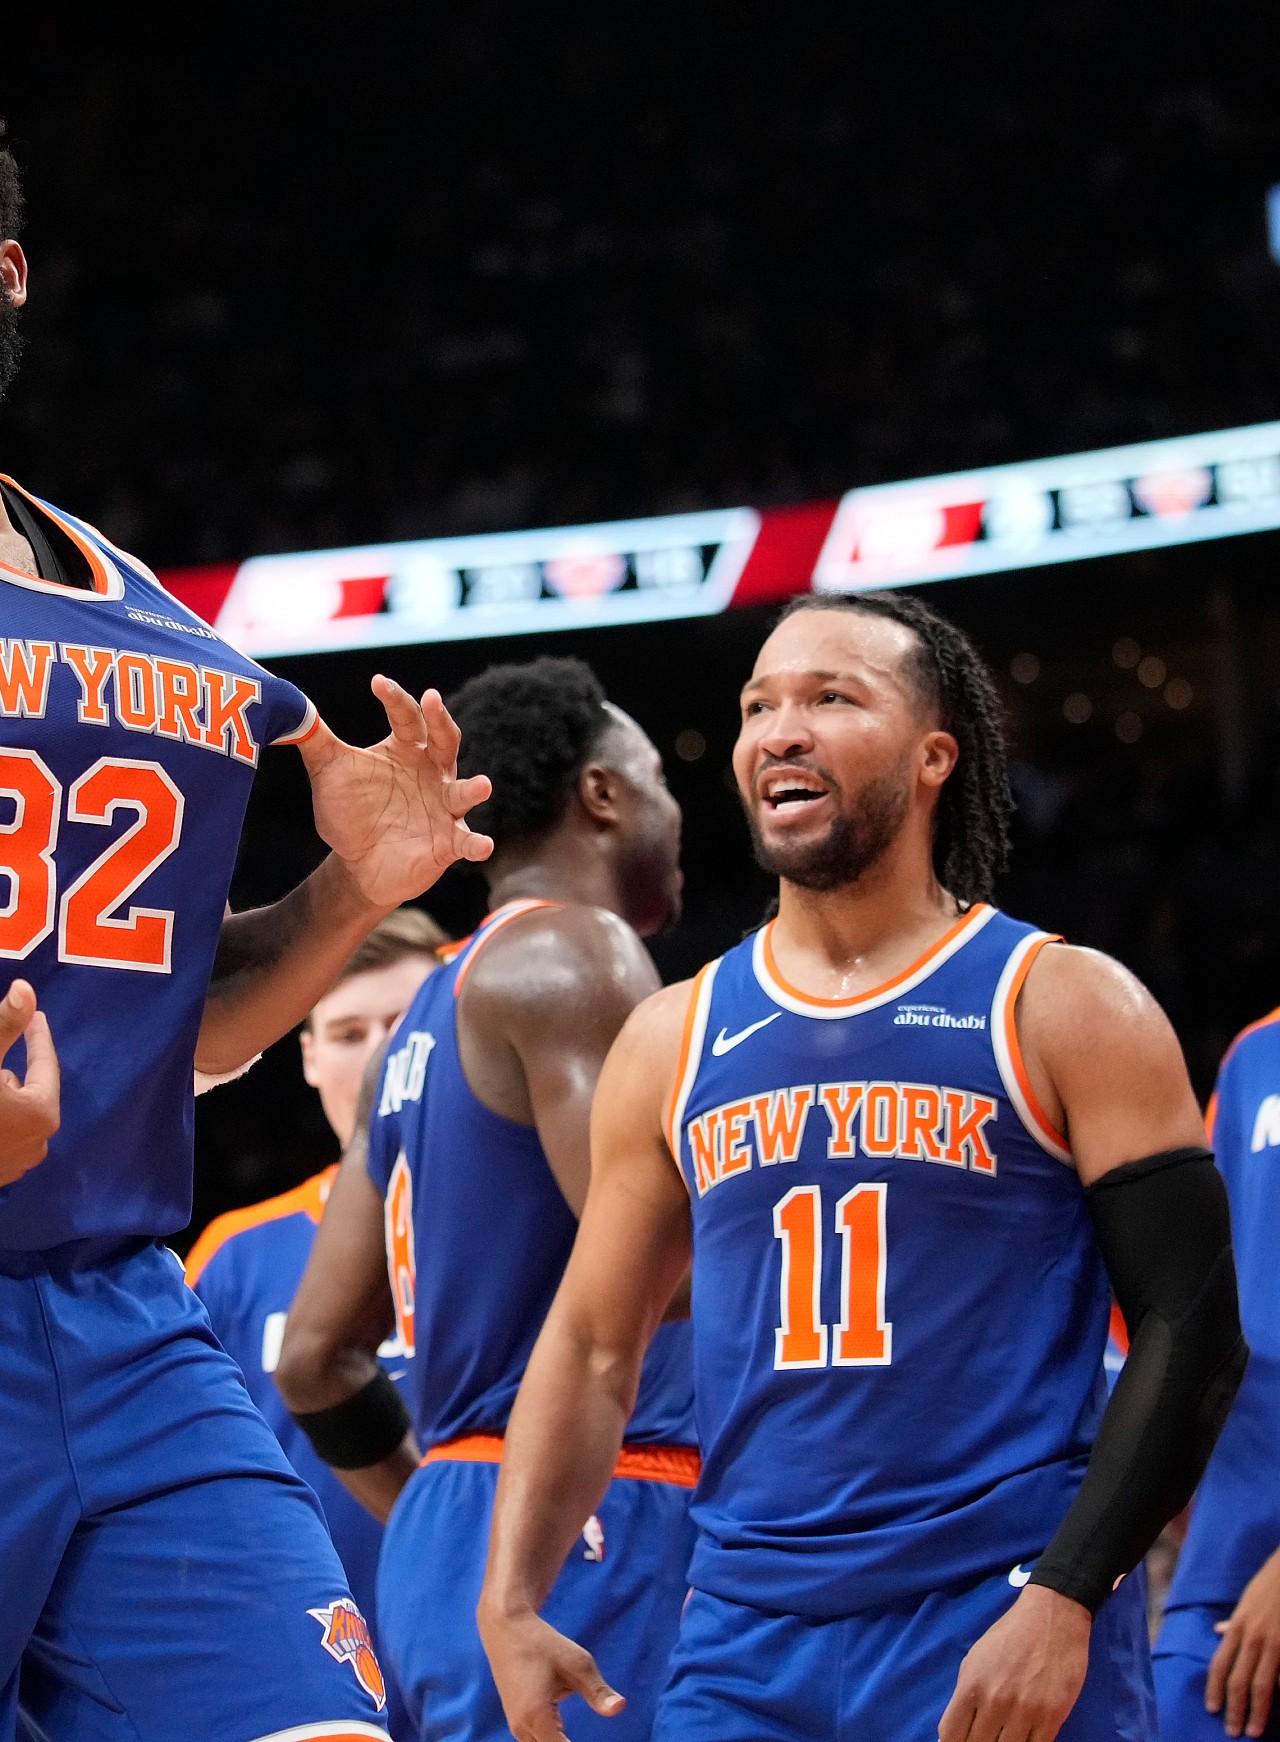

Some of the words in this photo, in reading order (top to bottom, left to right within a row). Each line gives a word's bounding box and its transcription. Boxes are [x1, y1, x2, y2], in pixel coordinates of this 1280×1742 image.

[127, 612, 163, 627] abu
[60, 642, 262, 769] YORK
[893, 1012, 930, 1026] abu
[931, 1014, 987, 1030] dhabi
[688, 1084, 816, 1199] NEW
[817, 1080, 998, 1178] YORK
[772, 1182, 892, 1371] 11
